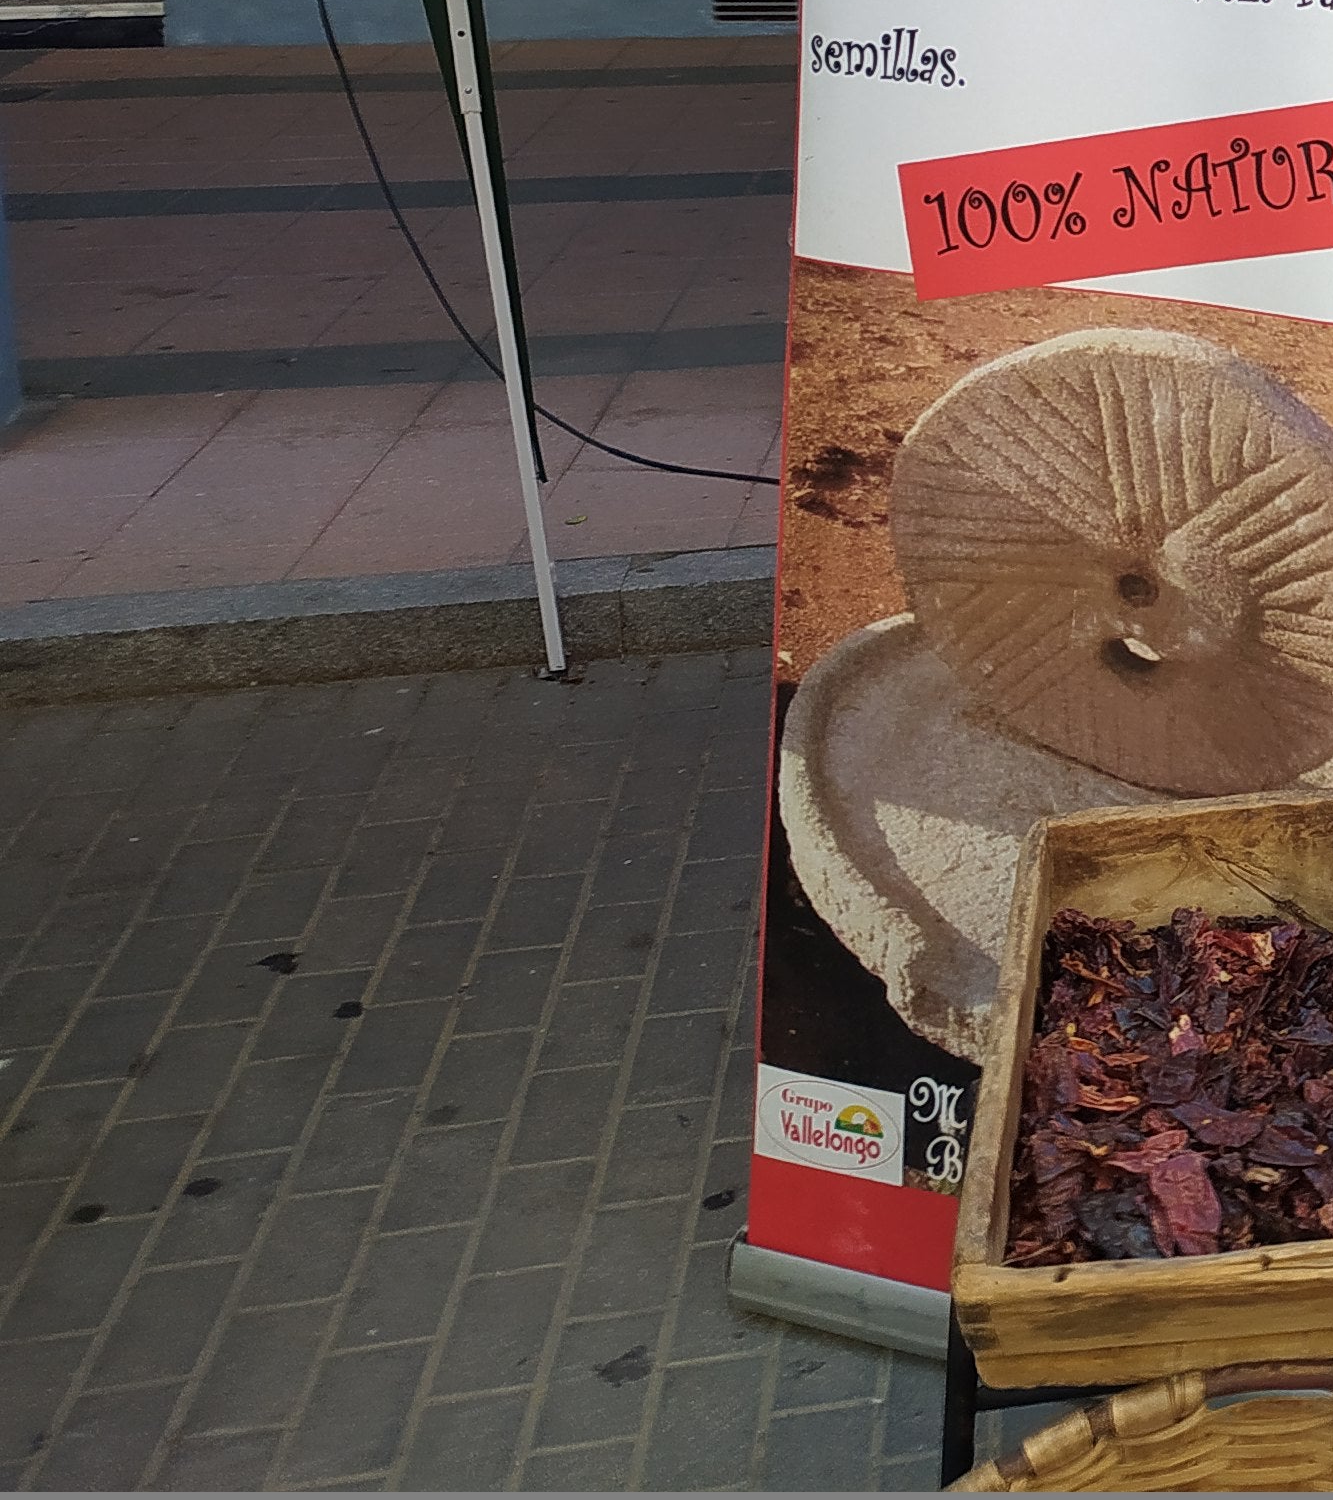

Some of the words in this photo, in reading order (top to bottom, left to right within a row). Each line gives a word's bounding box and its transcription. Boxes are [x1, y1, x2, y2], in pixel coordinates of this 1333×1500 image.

[810, 27, 965, 88] semillas.
[924, 172, 1088, 256] 100%
[781, 1088, 833, 1112] Grupo
[780, 1110, 881, 1164] Vallelongo
